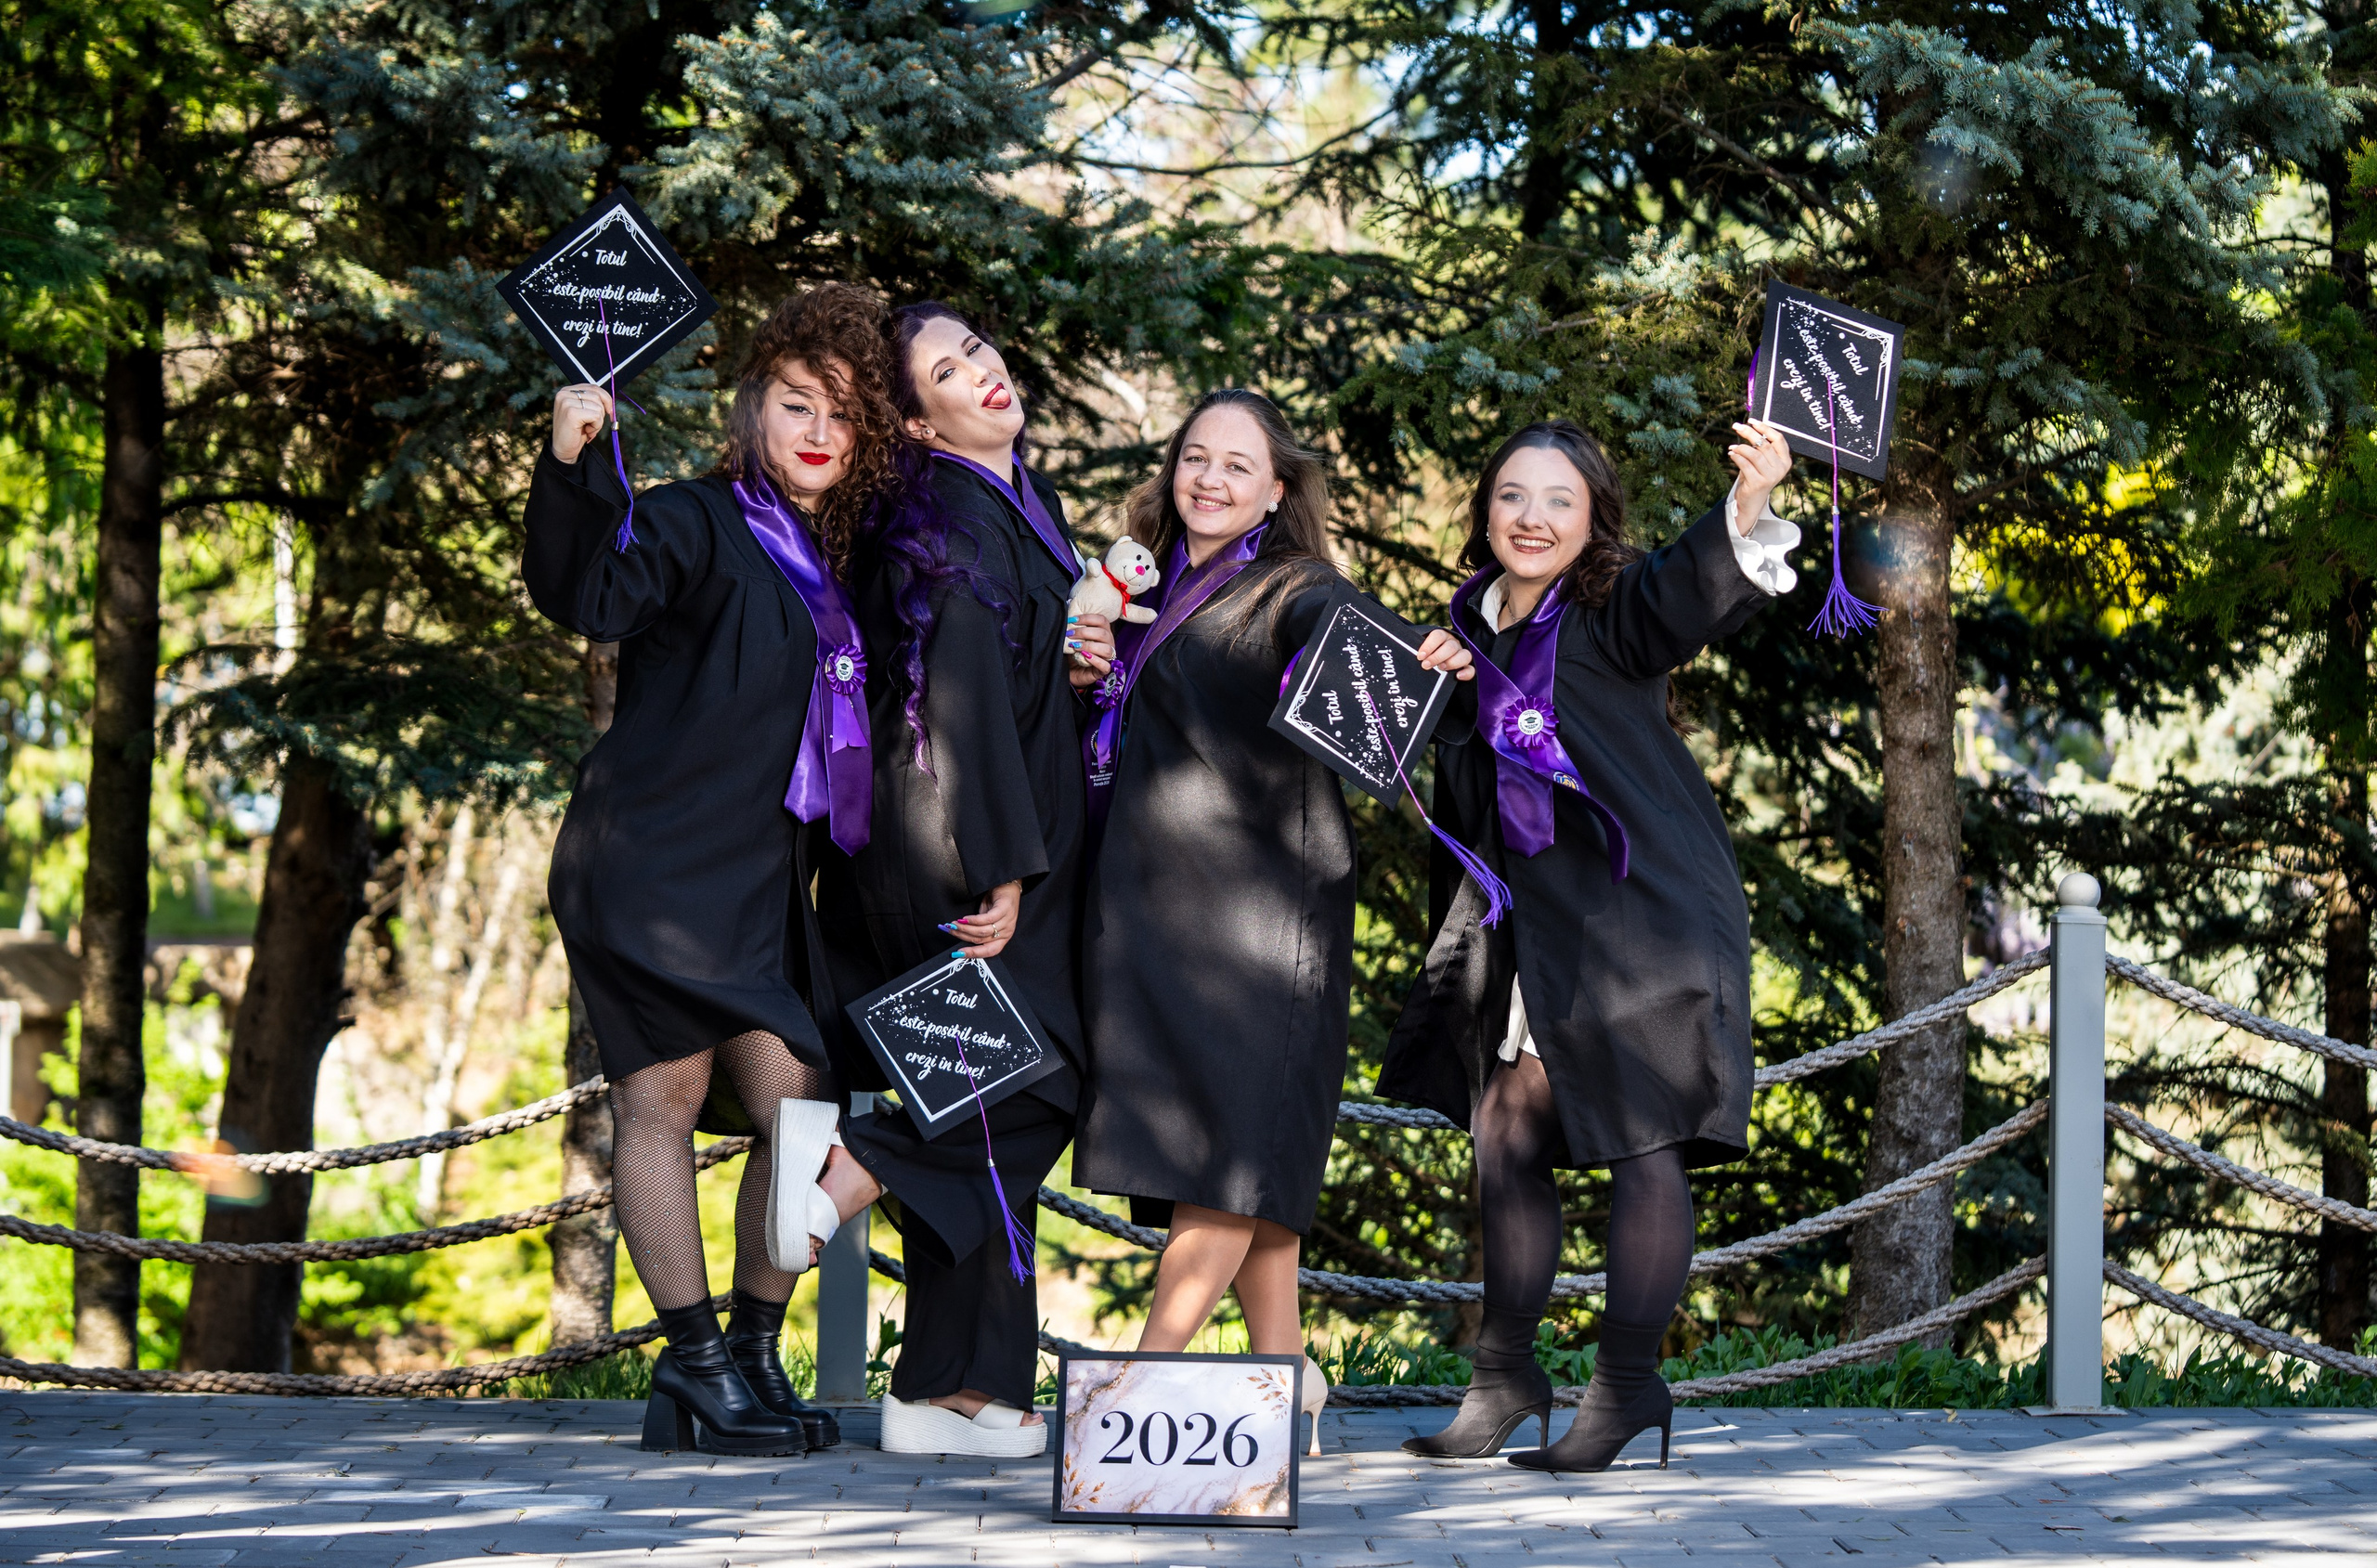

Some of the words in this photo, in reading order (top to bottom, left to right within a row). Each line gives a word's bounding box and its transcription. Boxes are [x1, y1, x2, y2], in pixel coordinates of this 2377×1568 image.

[595, 249, 628, 266] Totul
[553, 282, 579, 296] este
[578, 284, 625, 305] posibil
[626, 287, 659, 303] când
[563, 319, 594, 348] crezi
[613, 320, 643, 338] tine!
[1842, 343, 1869, 376] Totul
[1799, 330, 1818, 355] este
[1838, 395, 1864, 424] când
[1780, 358, 1808, 390] crezi
[1809, 400, 1832, 430] tine!
[1343, 644, 1363, 677] când
[1377, 649, 1396, 679] tine!
[1322, 690, 1344, 725] Totul
[1390, 695, 1419, 728] crezi
[1366, 722, 1381, 751] este
[945, 988, 978, 1009] Totul
[900, 1016, 927, 1030] este
[972, 1031, 1006, 1049] când
[905, 1052, 938, 1080] crezi
[955, 1060, 985, 1080] tine!
[1098, 1410, 1258, 1468] 2026
